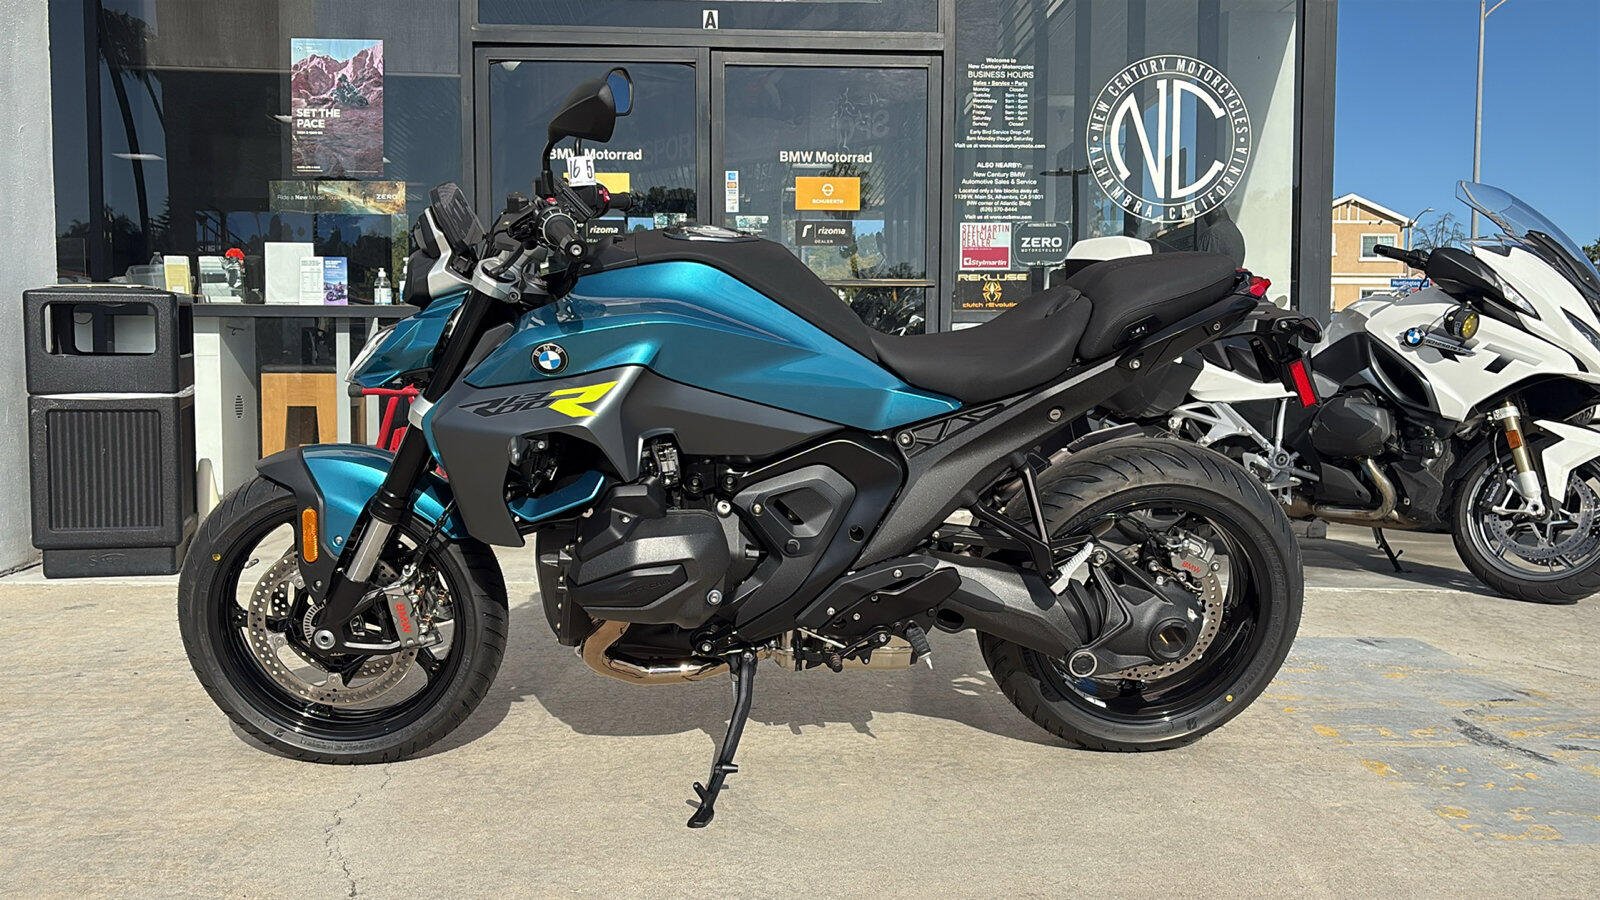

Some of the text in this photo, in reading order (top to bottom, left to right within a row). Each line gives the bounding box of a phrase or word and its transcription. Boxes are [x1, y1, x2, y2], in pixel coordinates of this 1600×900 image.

[704, 11, 716, 28] A
[1091, 57, 1249, 134] NEW CENTURY MOTORCYCLES
[296, 108, 340, 118] SET THE
[296, 119, 326, 128] PACE
[584, 148, 642, 160] Motorrad
[780, 150, 872, 163] BMW Motorrad
[1090, 146, 1248, 220] ALHAMBRA CALIFORNIA
[590, 226, 618, 234] rizoma
[818, 226, 846, 235] rizoma
[962, 231, 996, 240] OFFICIAL
[1021, 237, 1062, 247] ZERO
[1182, 560, 1200, 573] BMW
[395, 602, 412, 632] BMW
